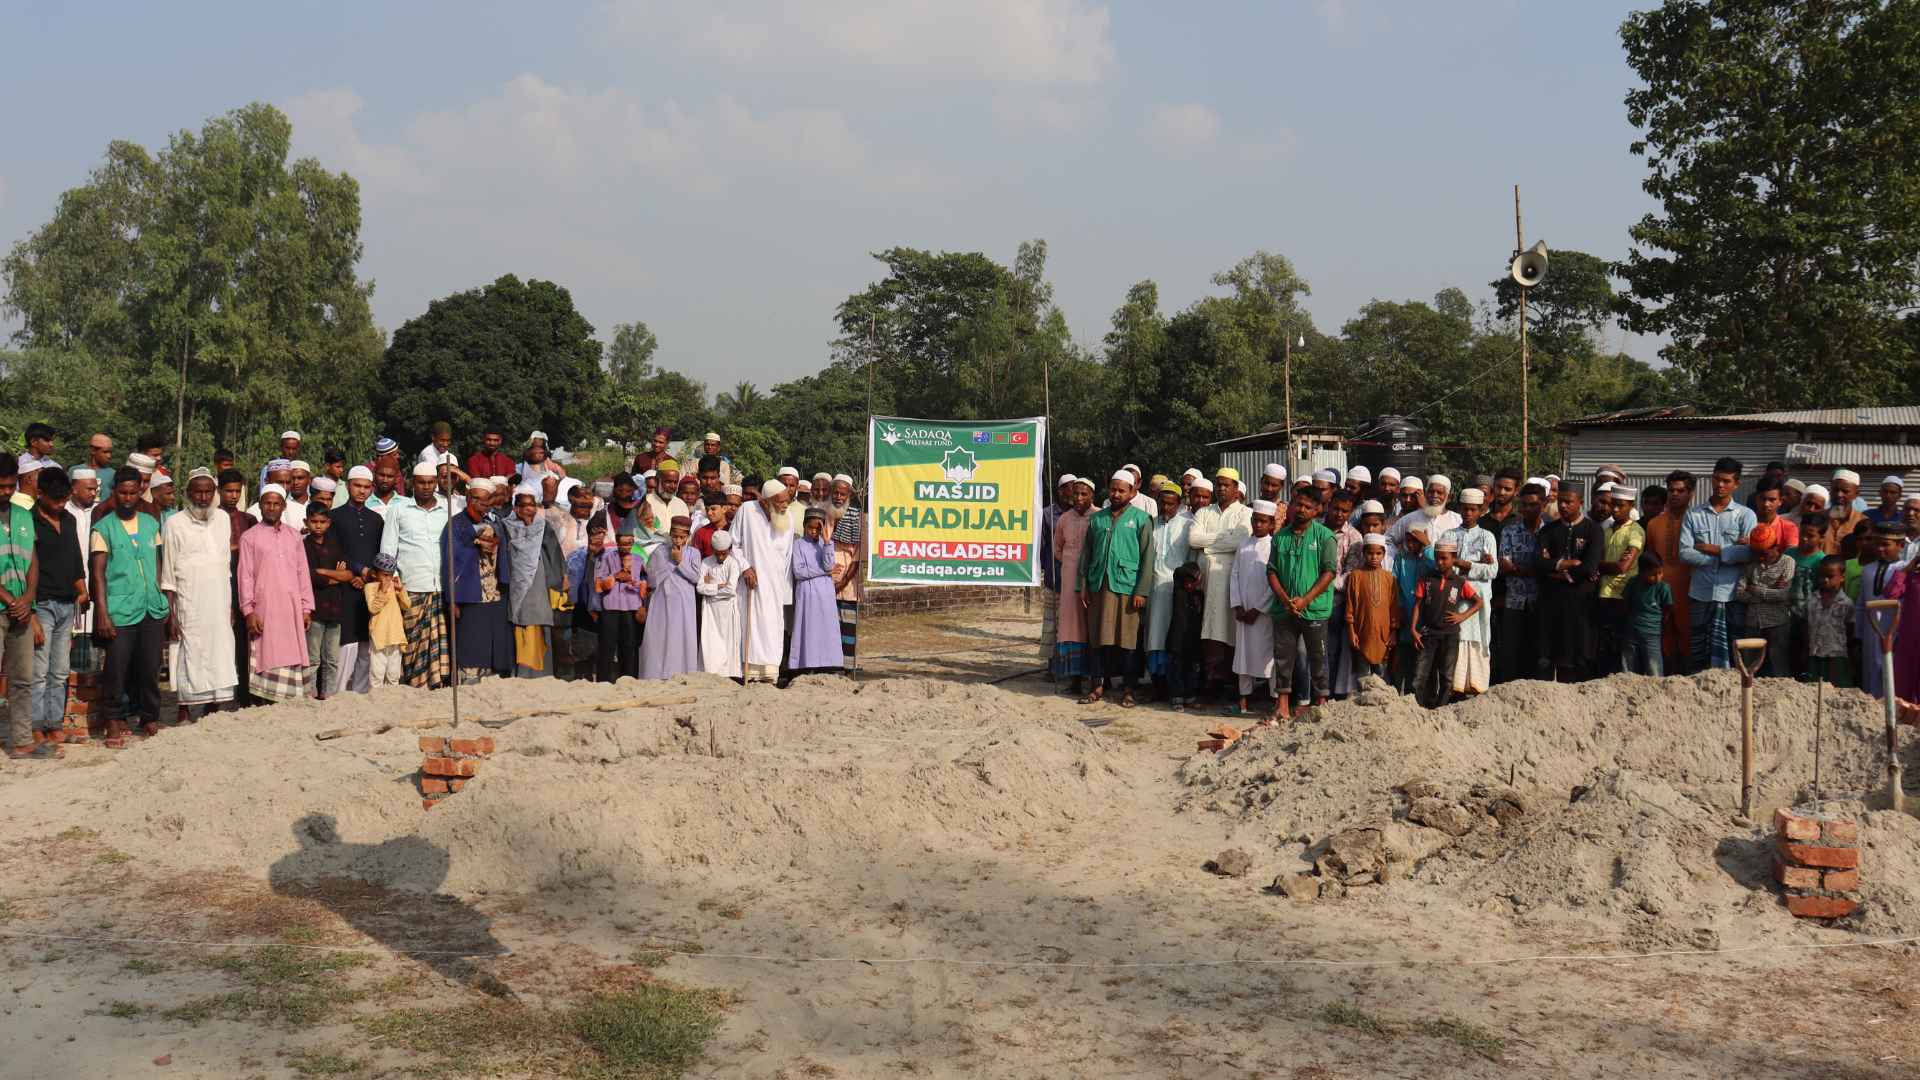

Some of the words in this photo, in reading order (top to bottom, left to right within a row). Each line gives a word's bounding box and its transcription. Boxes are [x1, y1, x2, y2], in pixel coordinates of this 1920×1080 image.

[904, 428, 952, 440] SADAQA
[919, 484, 996, 500] MASJID
[879, 506, 1028, 530] KHADIJAH
[883, 541, 1021, 560] BANGLADESH
[900, 563, 1004, 577] sadaqa.org.au
